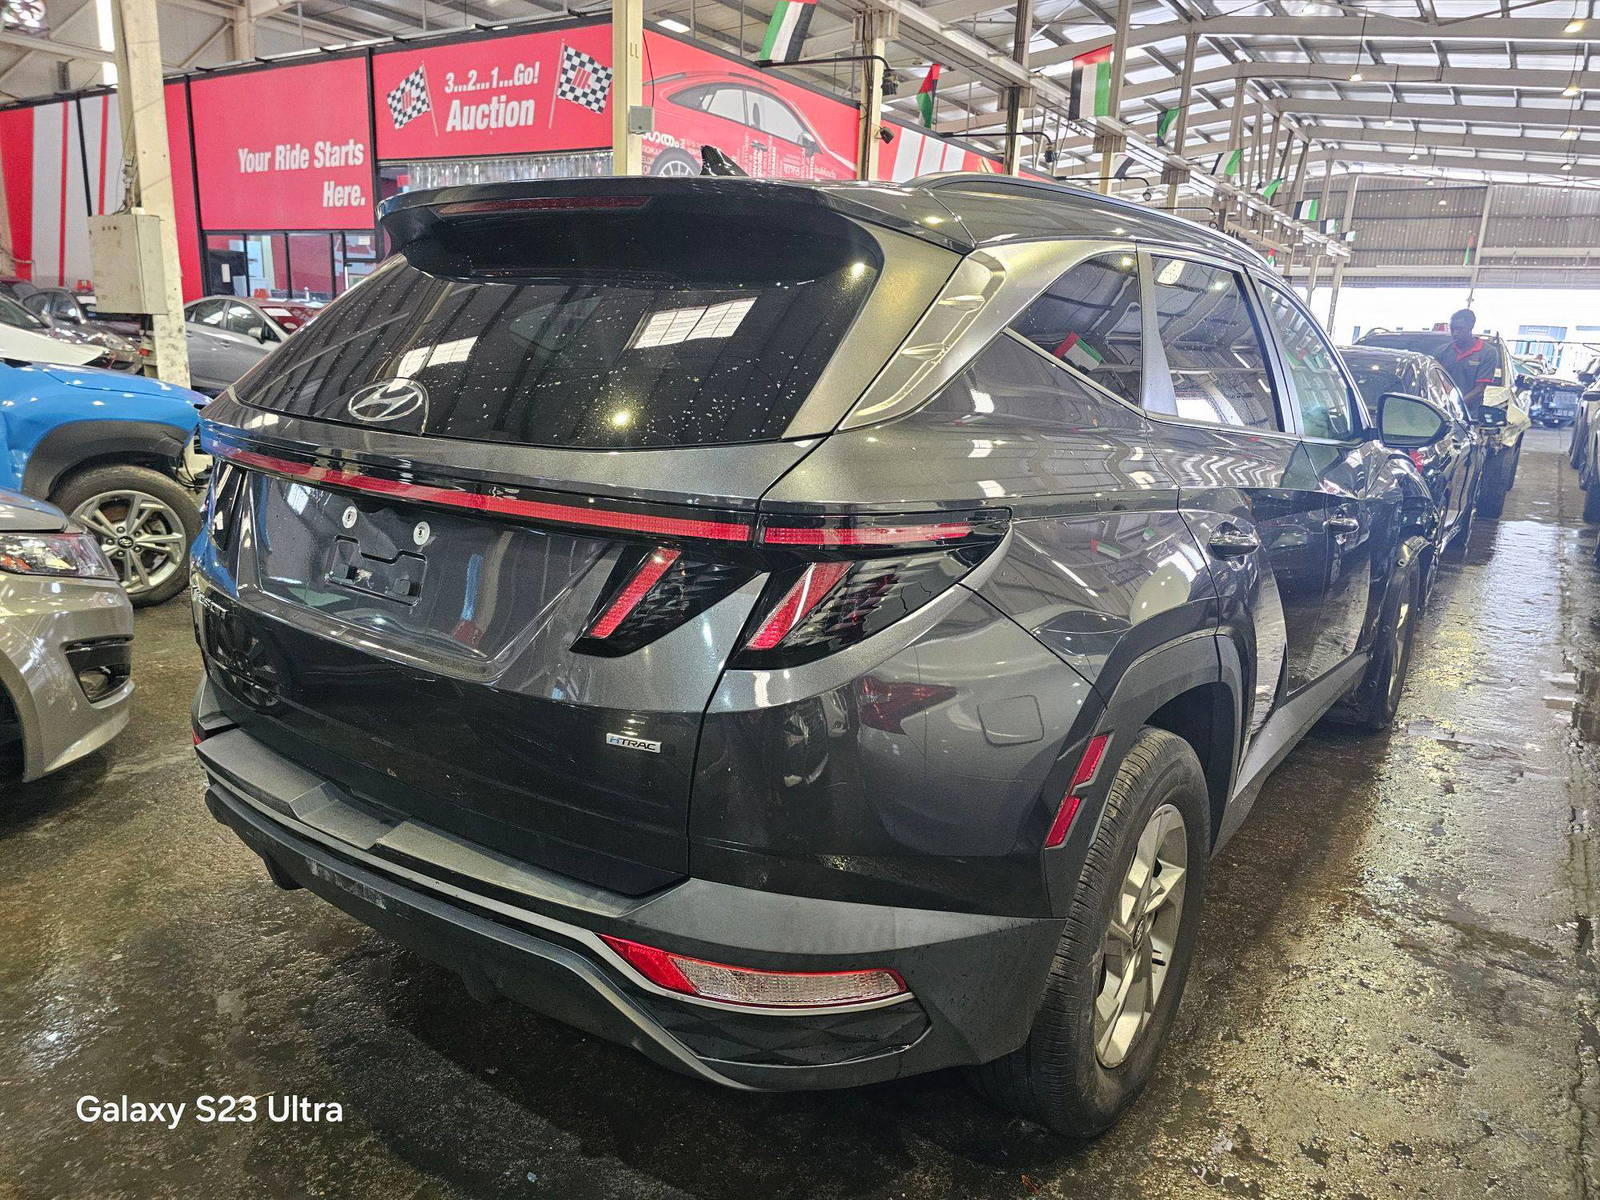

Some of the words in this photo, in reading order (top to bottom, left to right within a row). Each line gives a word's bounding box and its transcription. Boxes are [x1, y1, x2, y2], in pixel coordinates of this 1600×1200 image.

[446, 95, 536, 132] Auction
[238, 147, 272, 173] Your
[275, 143, 309, 171] Ride
[313, 138, 364, 168] Starts
[323, 181, 366, 208] Here.
